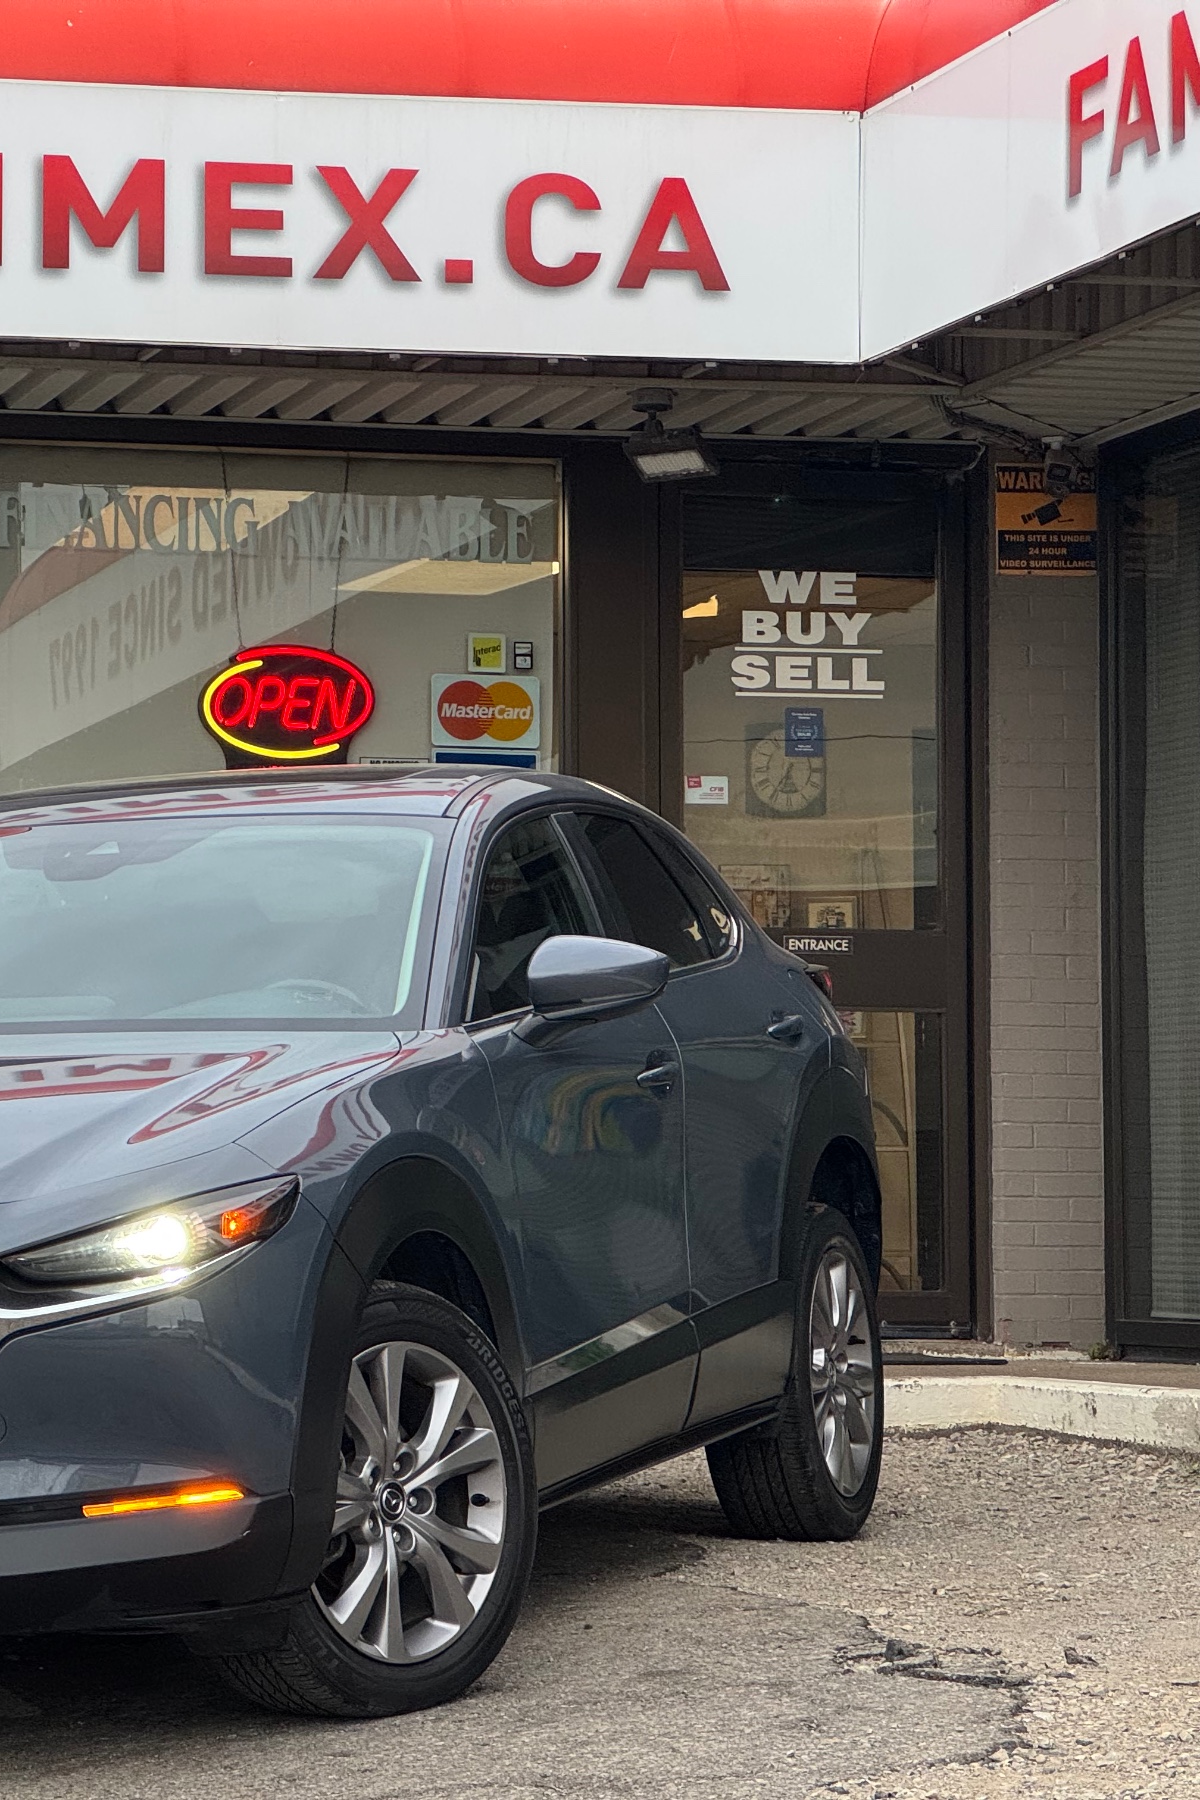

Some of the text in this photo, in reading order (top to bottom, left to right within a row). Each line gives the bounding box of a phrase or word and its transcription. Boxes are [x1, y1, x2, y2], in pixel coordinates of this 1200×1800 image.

[998, 470, 1096, 491] WARG!
[283, 498, 535, 565] AVAILABLE
[1004, 534, 1092, 543] THIS SITE IS UNDER
[1028, 547, 1068, 555] 24 HOUR
[1000, 559, 1097, 569] VIDEO SURVEILLANCE
[758, 569, 858, 605] WE
[741, 610, 873, 646] BUY
[730, 654, 886, 691] SELL
[212, 674, 357, 731] OPEN
[440, 702, 532, 720] MasterCard
[788, 938, 849, 951] ENTRANCE
